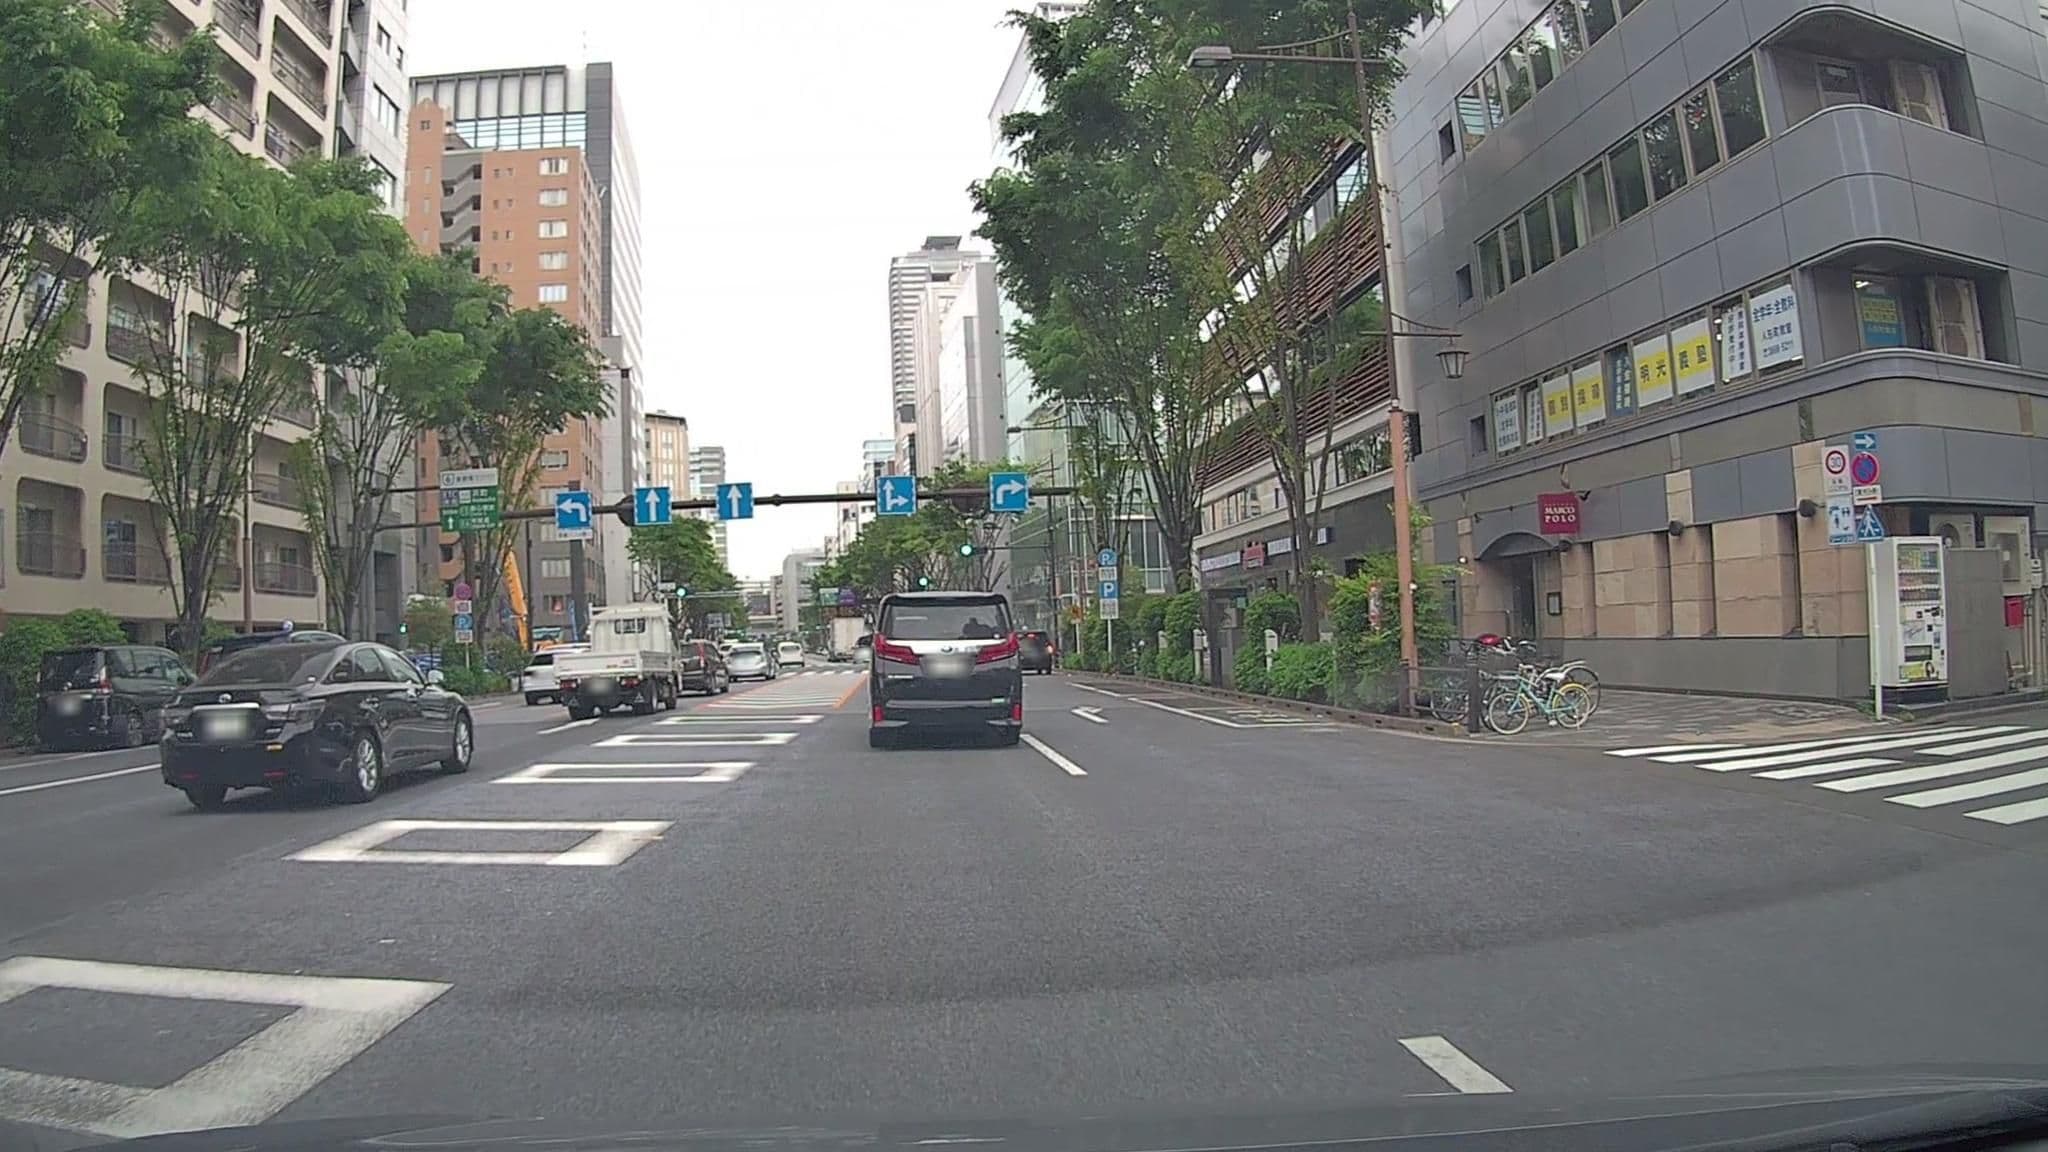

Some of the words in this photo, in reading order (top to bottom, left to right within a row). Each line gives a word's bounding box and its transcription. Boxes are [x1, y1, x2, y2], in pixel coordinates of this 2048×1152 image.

[1830, 456, 1843, 469] 30
[1544, 506, 1576, 515] MARCO
[1544, 514, 1577, 523] POLO
[1103, 582, 1114, 597] P
